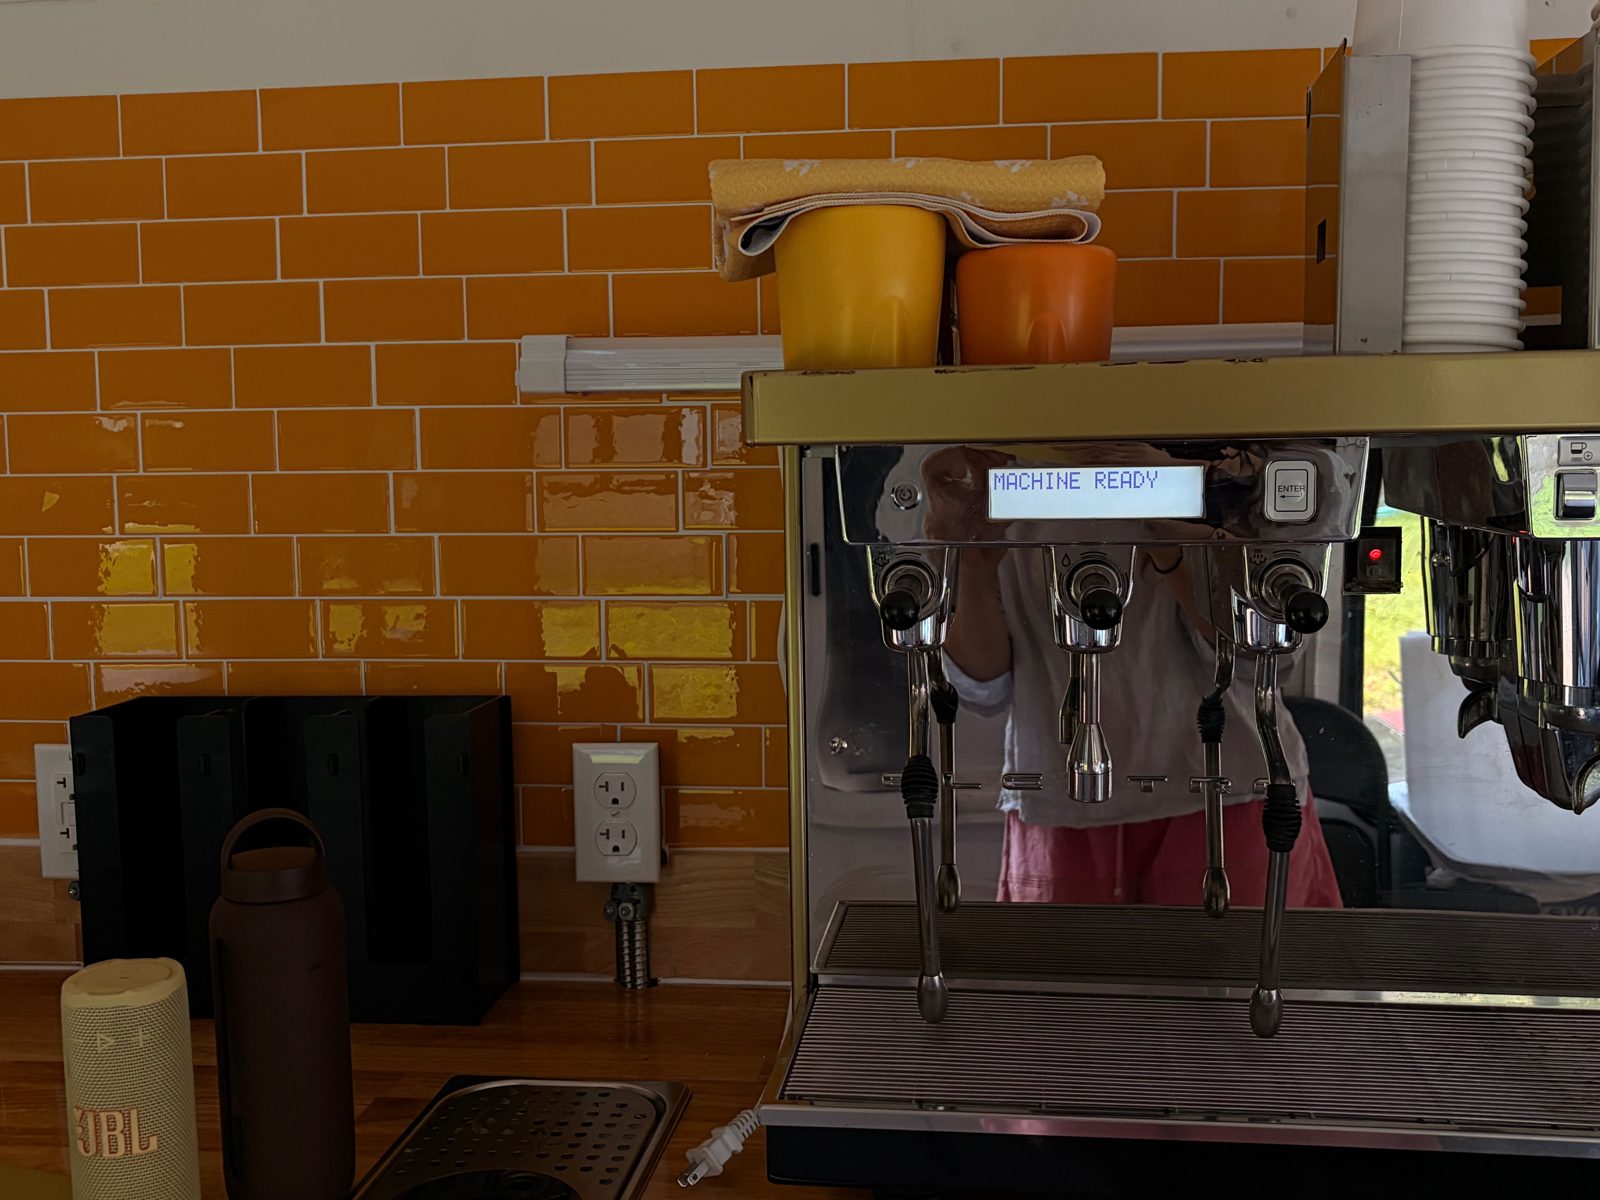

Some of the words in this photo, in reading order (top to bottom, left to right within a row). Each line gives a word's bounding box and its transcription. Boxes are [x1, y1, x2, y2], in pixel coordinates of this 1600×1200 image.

[993, 470, 1081, 491] MACHINE
[1094, 470, 1159, 490] READY
[1277, 484, 1306, 493] ENTER
[74, 1107, 158, 1158] JBL
